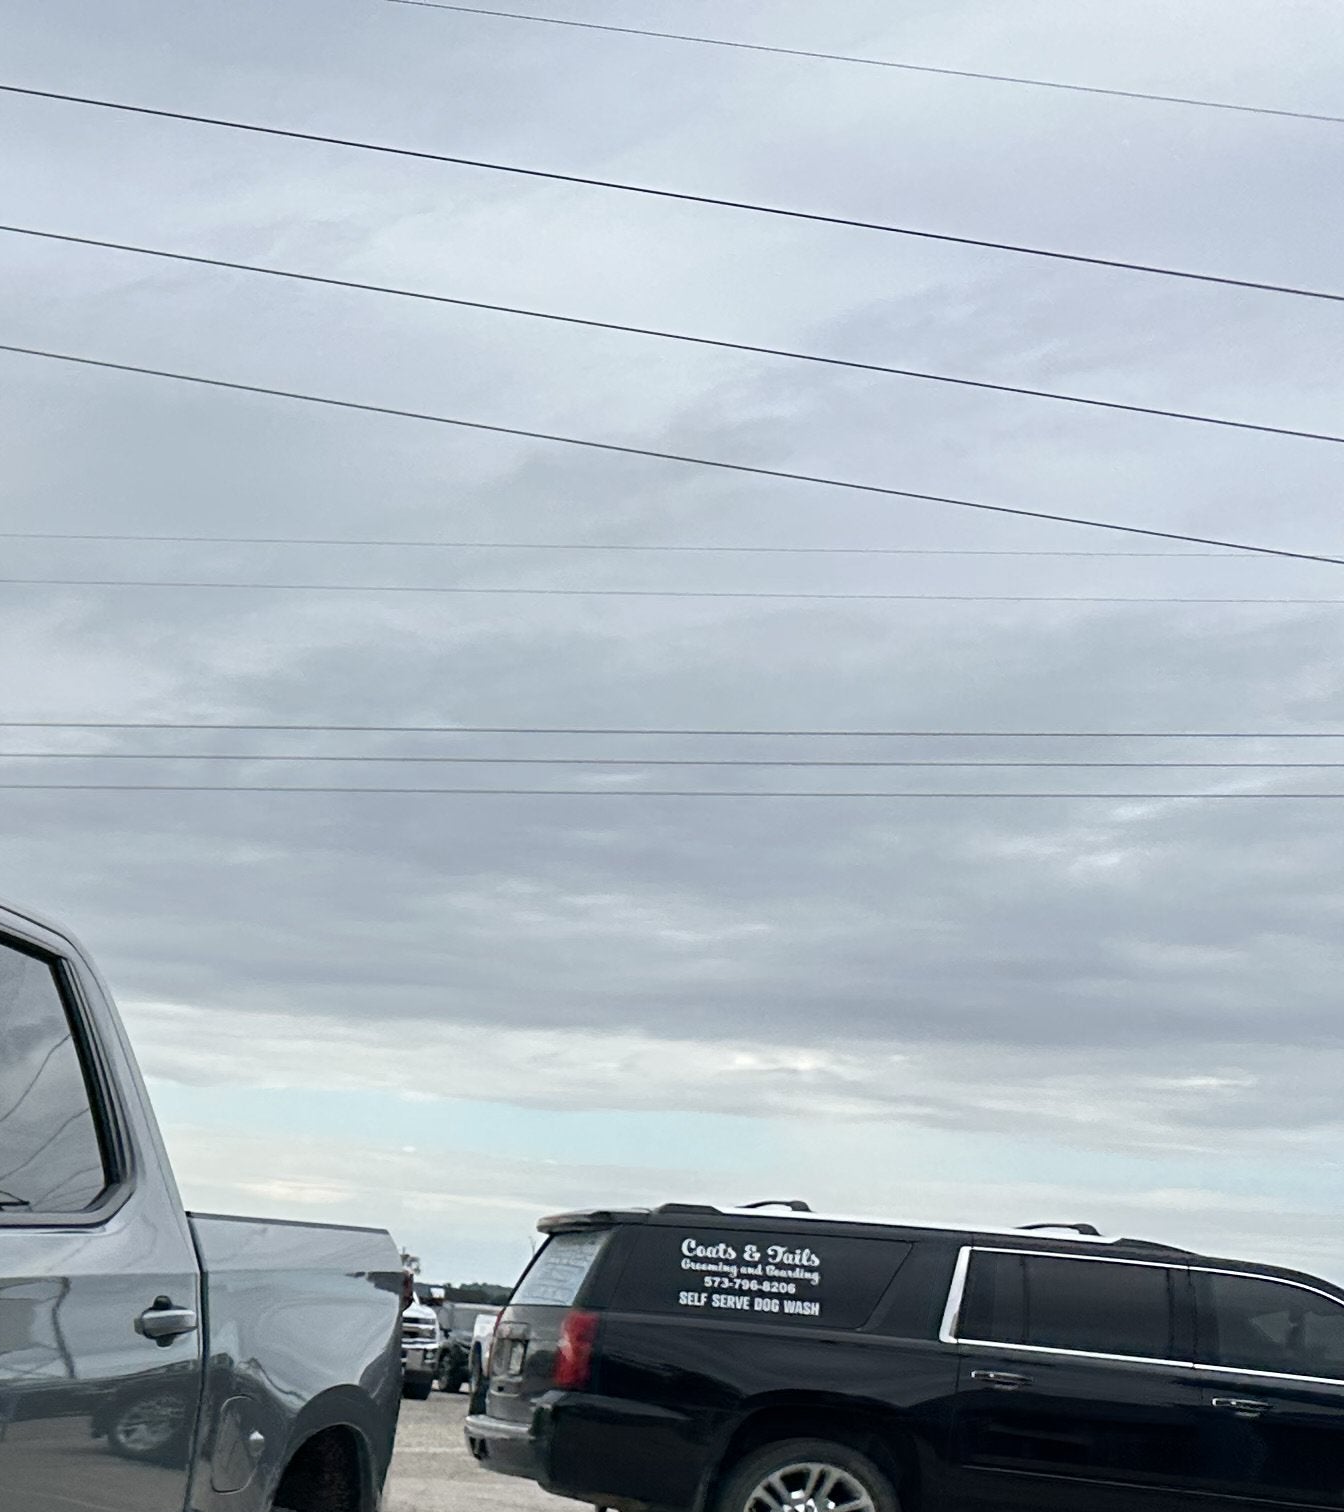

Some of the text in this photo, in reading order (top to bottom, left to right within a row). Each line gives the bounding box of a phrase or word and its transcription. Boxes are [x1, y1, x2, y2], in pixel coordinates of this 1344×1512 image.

[681, 1238, 820, 1267] Coats & Tails
[680, 1258, 820, 1286] Grooming and Boarding
[703, 1276, 796, 1294] 573-796-8206
[678, 1291, 820, 1316] SELF SERVE DOG WASH
